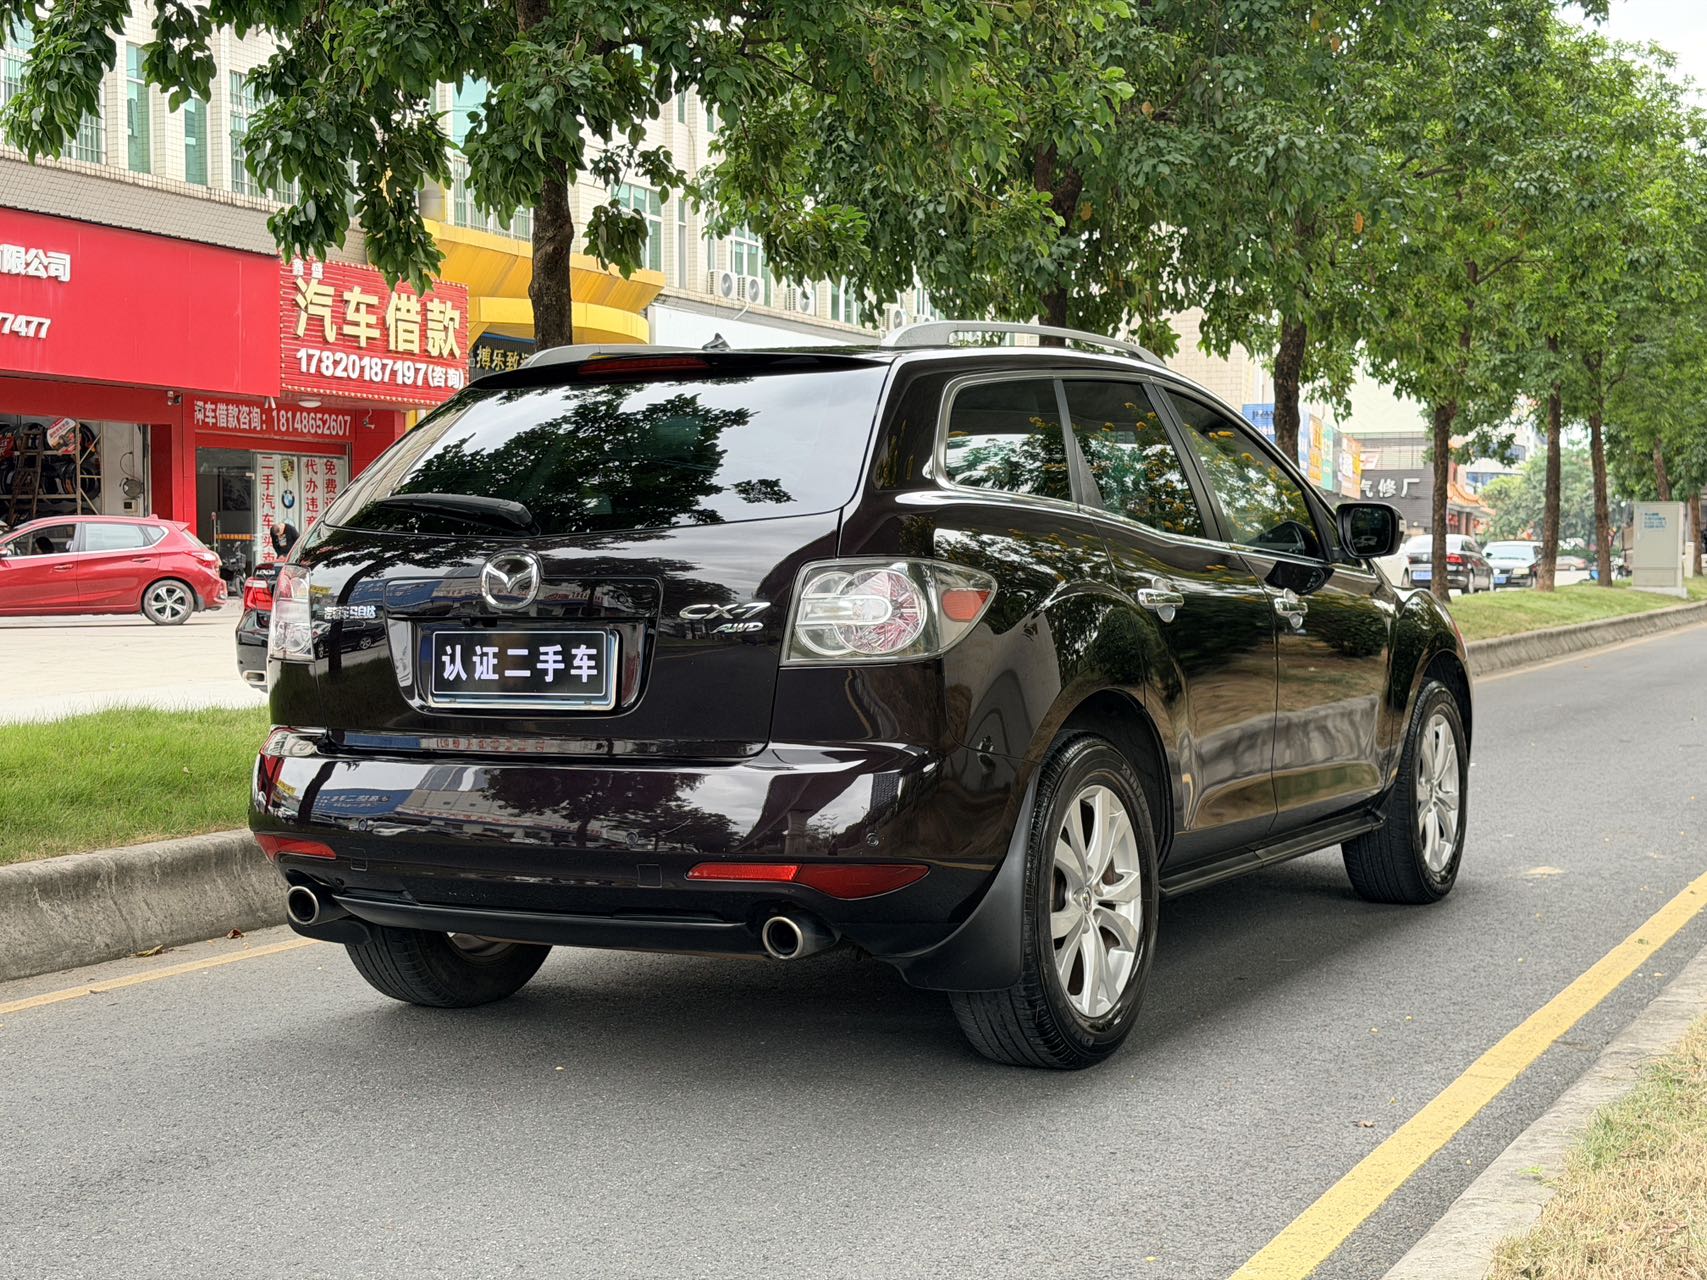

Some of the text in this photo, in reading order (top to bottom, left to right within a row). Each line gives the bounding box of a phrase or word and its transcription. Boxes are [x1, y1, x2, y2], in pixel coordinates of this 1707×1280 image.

[0, 243, 71, 282] 限公司
[295, 276, 461, 359] 汽车借款
[679, 601, 772, 620] CX-7
[709, 621, 764, 634] AWD
[440, 644, 599, 683] 认证二手车
